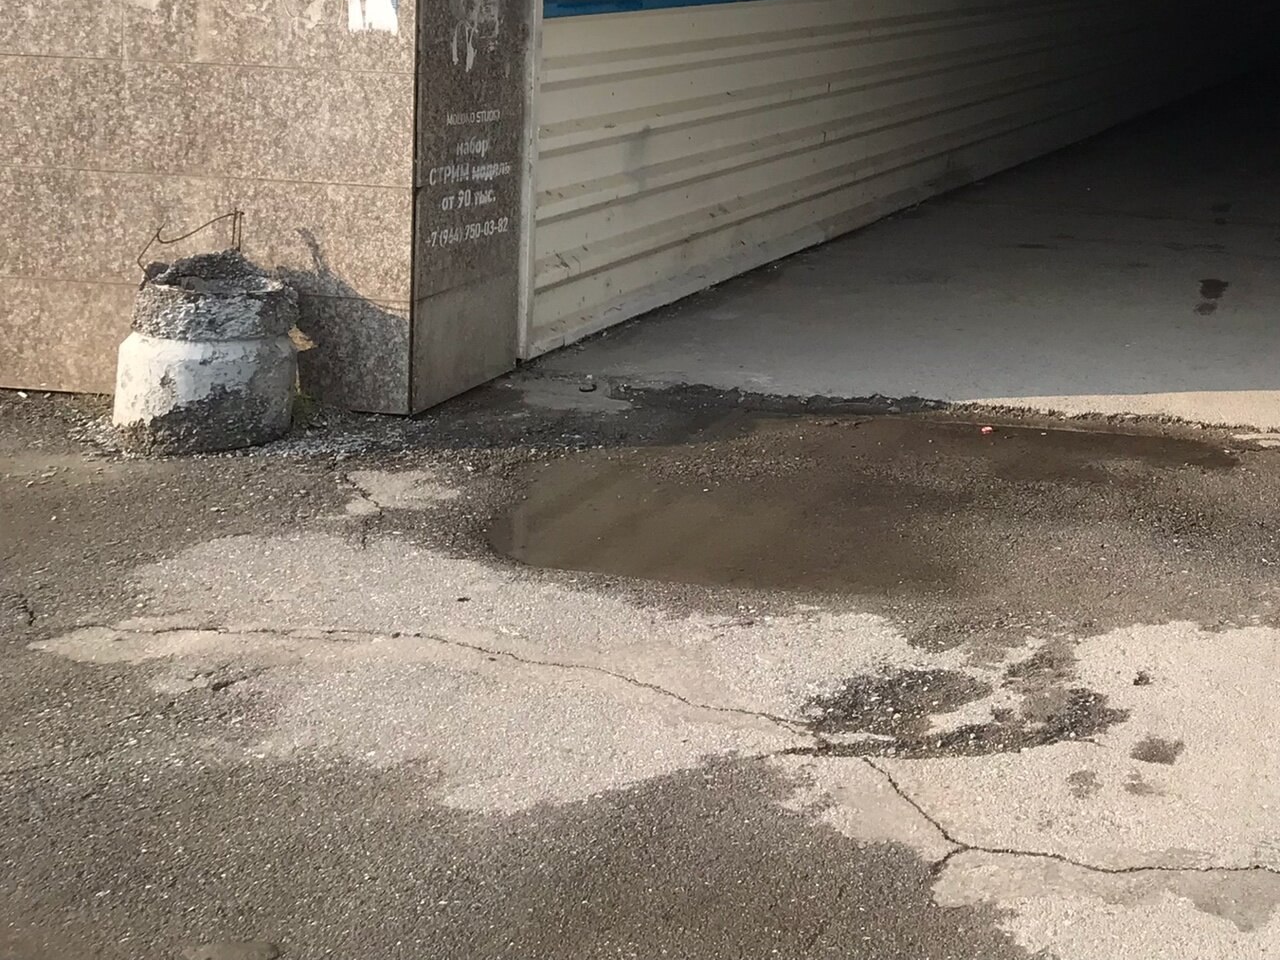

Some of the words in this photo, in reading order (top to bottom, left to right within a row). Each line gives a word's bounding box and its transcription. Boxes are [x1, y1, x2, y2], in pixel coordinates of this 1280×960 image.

[456, 136, 488, 158] набор
[429, 163, 469, 186] СТРИМ
[441, 195, 455, 211] от
